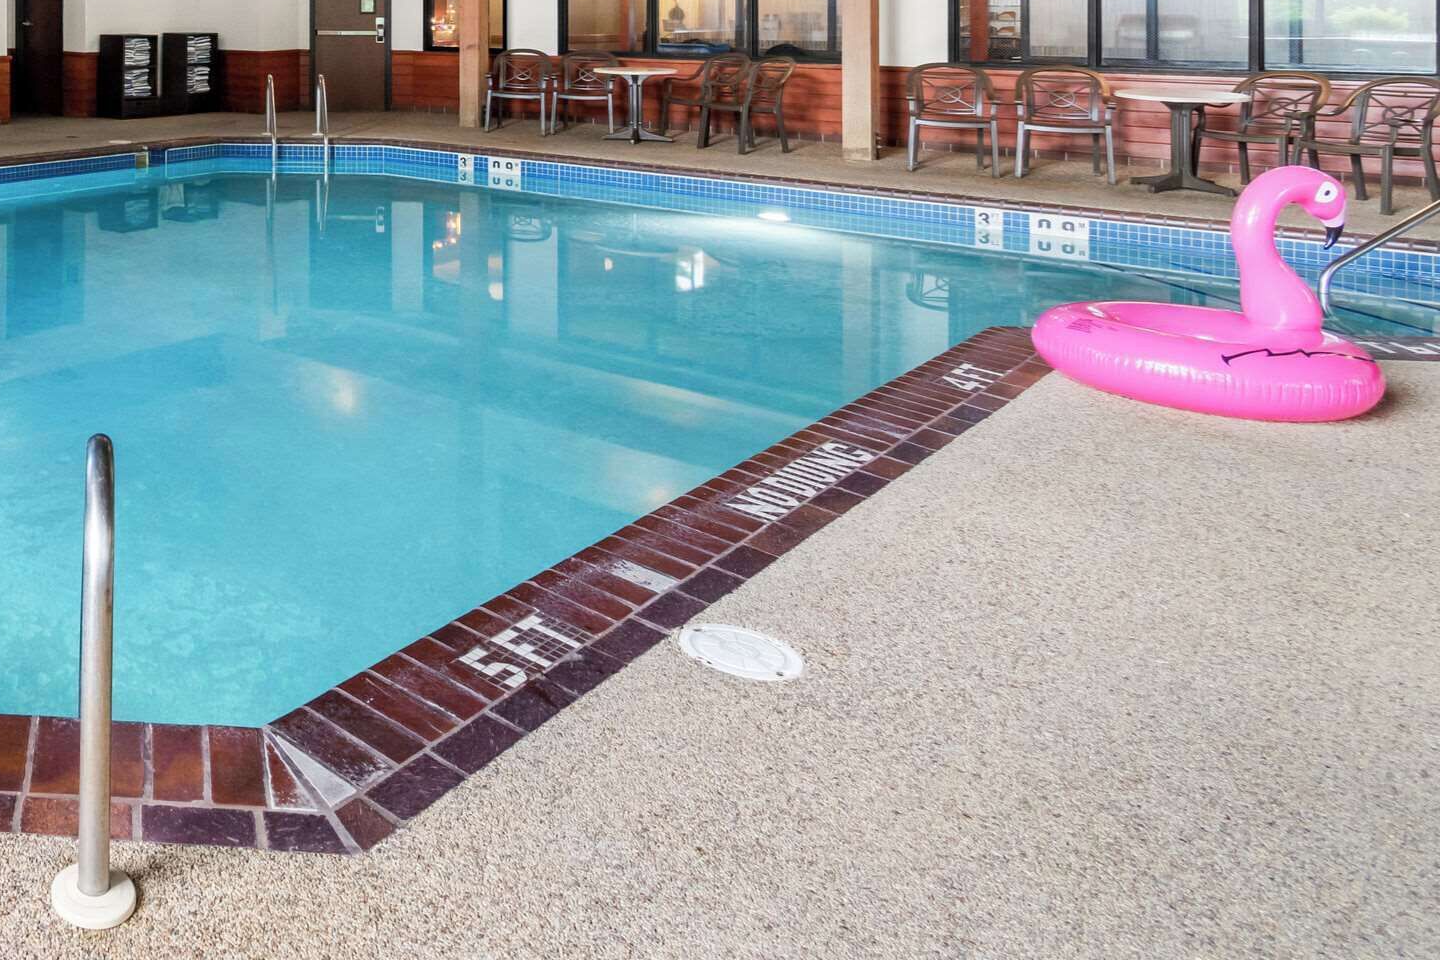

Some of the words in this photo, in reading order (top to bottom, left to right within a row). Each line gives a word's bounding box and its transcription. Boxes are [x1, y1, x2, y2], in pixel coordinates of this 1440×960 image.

[761, 442, 875, 497] DIVING
[726, 487, 800, 520] NO
[459, 615, 582, 688] 5FT
